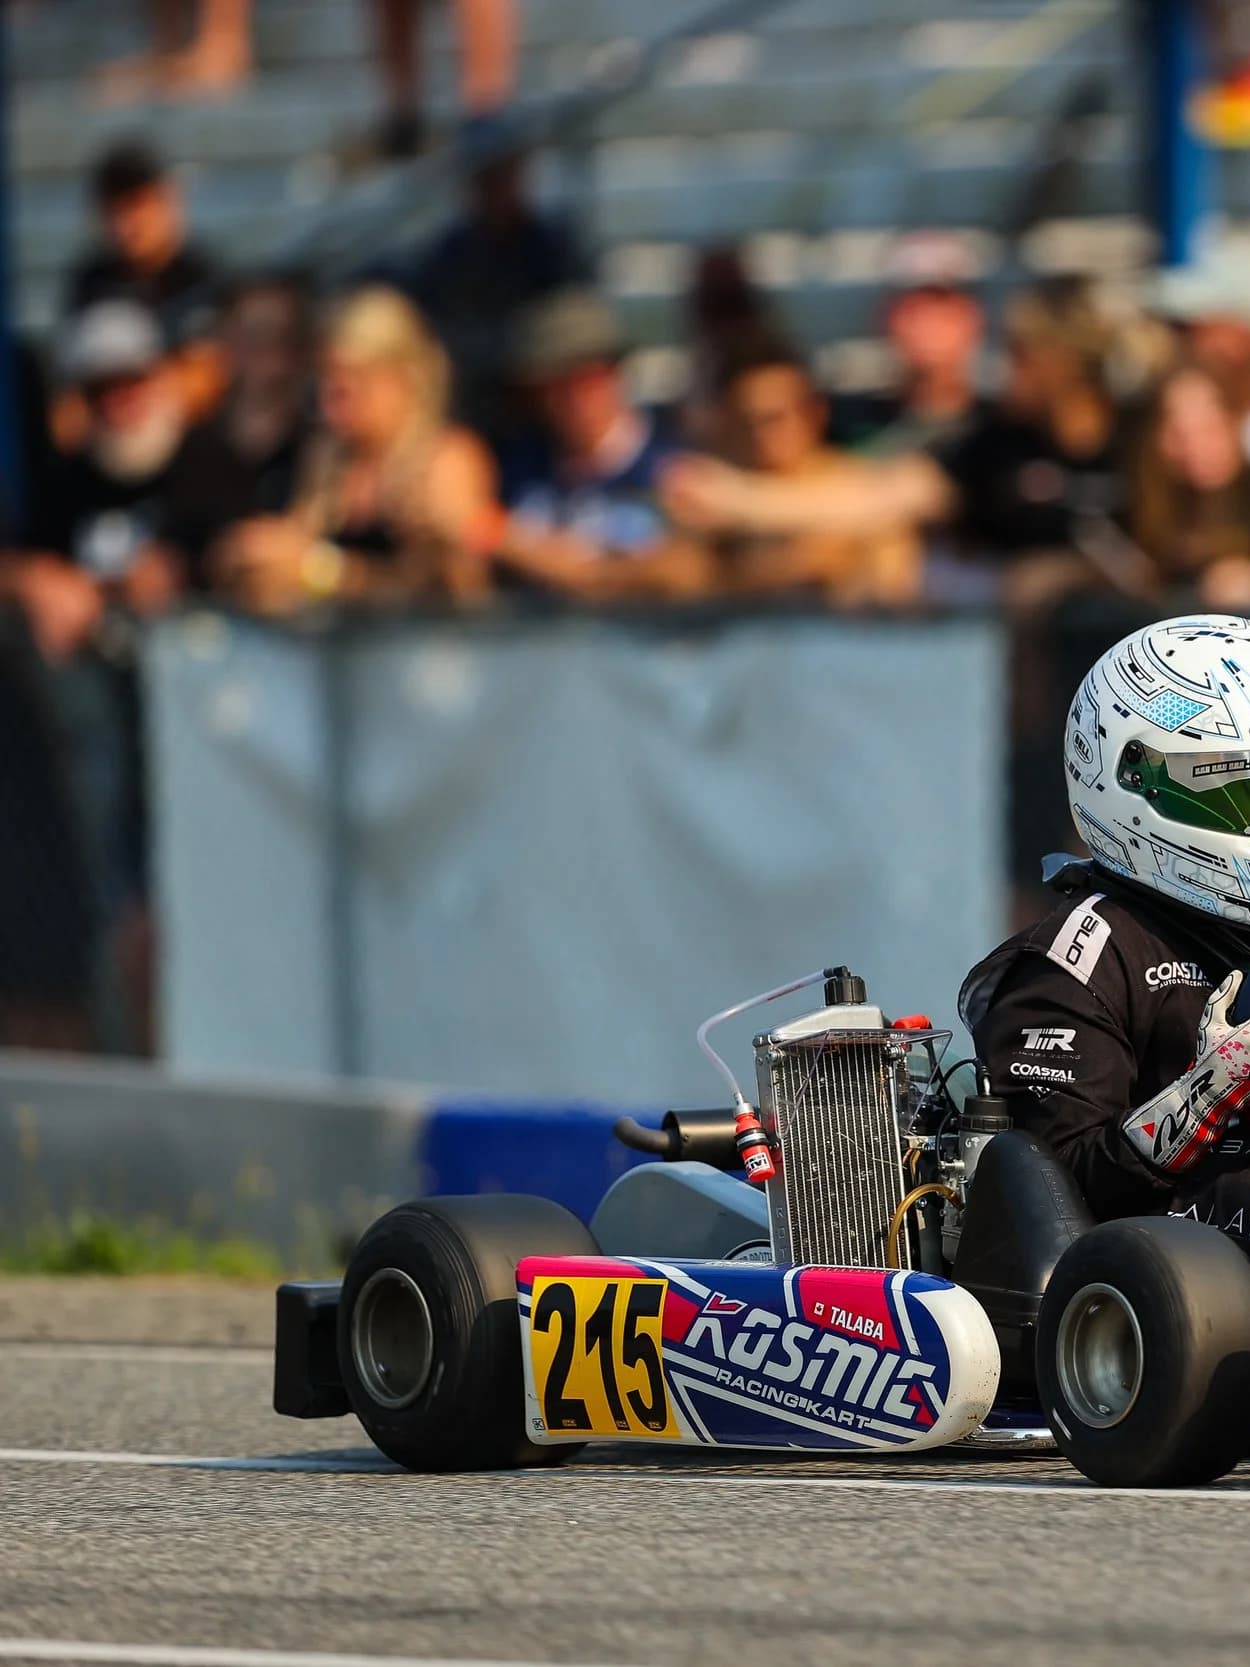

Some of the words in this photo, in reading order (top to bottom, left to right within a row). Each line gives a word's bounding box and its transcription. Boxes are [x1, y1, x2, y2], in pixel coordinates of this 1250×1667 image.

[1066, 915, 1098, 966] one
[1010, 1062, 1077, 1082] COASTAL
[830, 1306, 884, 1341] TALABA
[533, 1282, 667, 1433] 215
[685, 1291, 936, 1420] KOSMIC
[715, 1368, 802, 1408] RACING
[804, 1400, 872, 1429] KART
